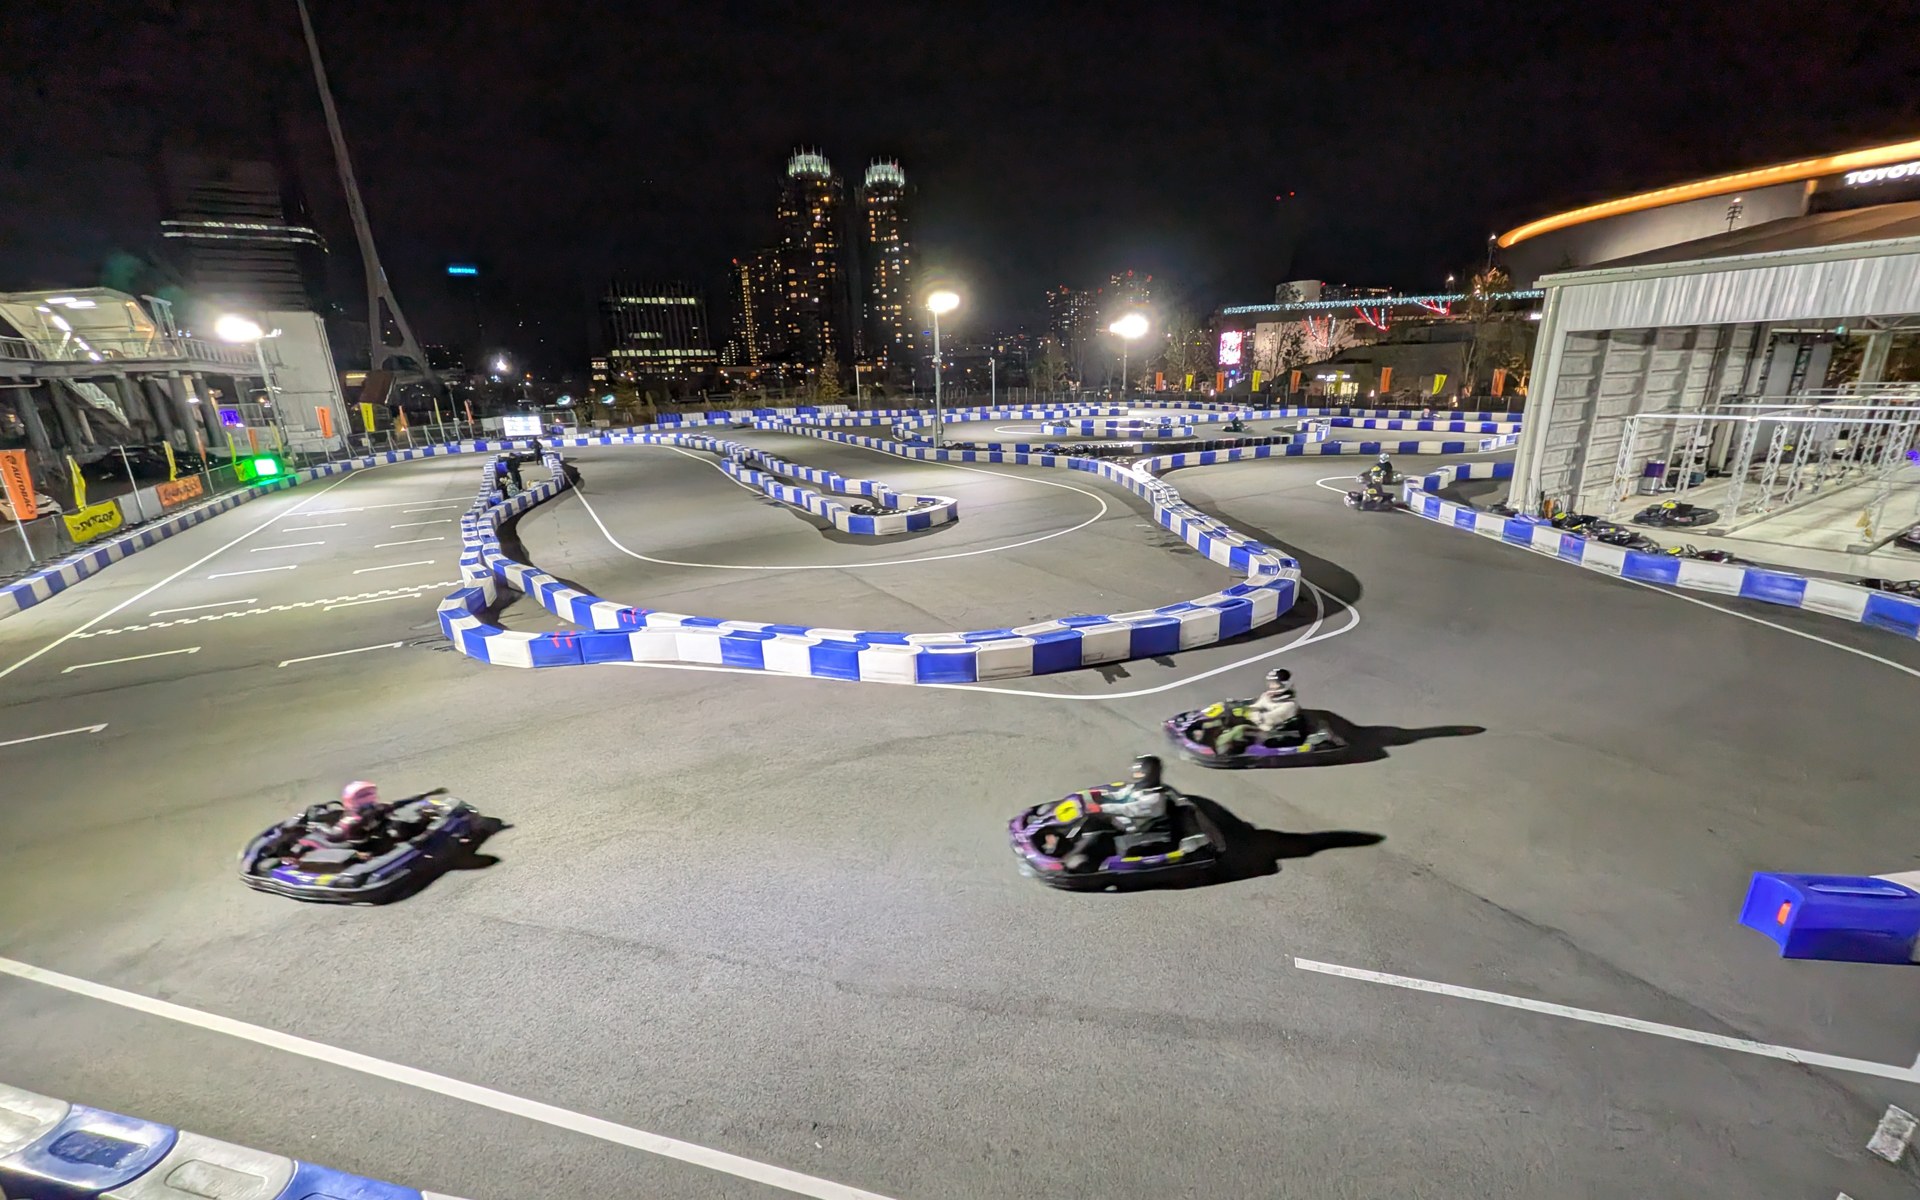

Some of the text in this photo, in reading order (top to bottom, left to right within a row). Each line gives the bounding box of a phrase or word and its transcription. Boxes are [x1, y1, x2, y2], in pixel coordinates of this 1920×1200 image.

[1844, 161, 1920, 186] TOYOT
[11, 466, 35, 515] AUTOBACS
[79, 510, 115, 532] DUNLOP
